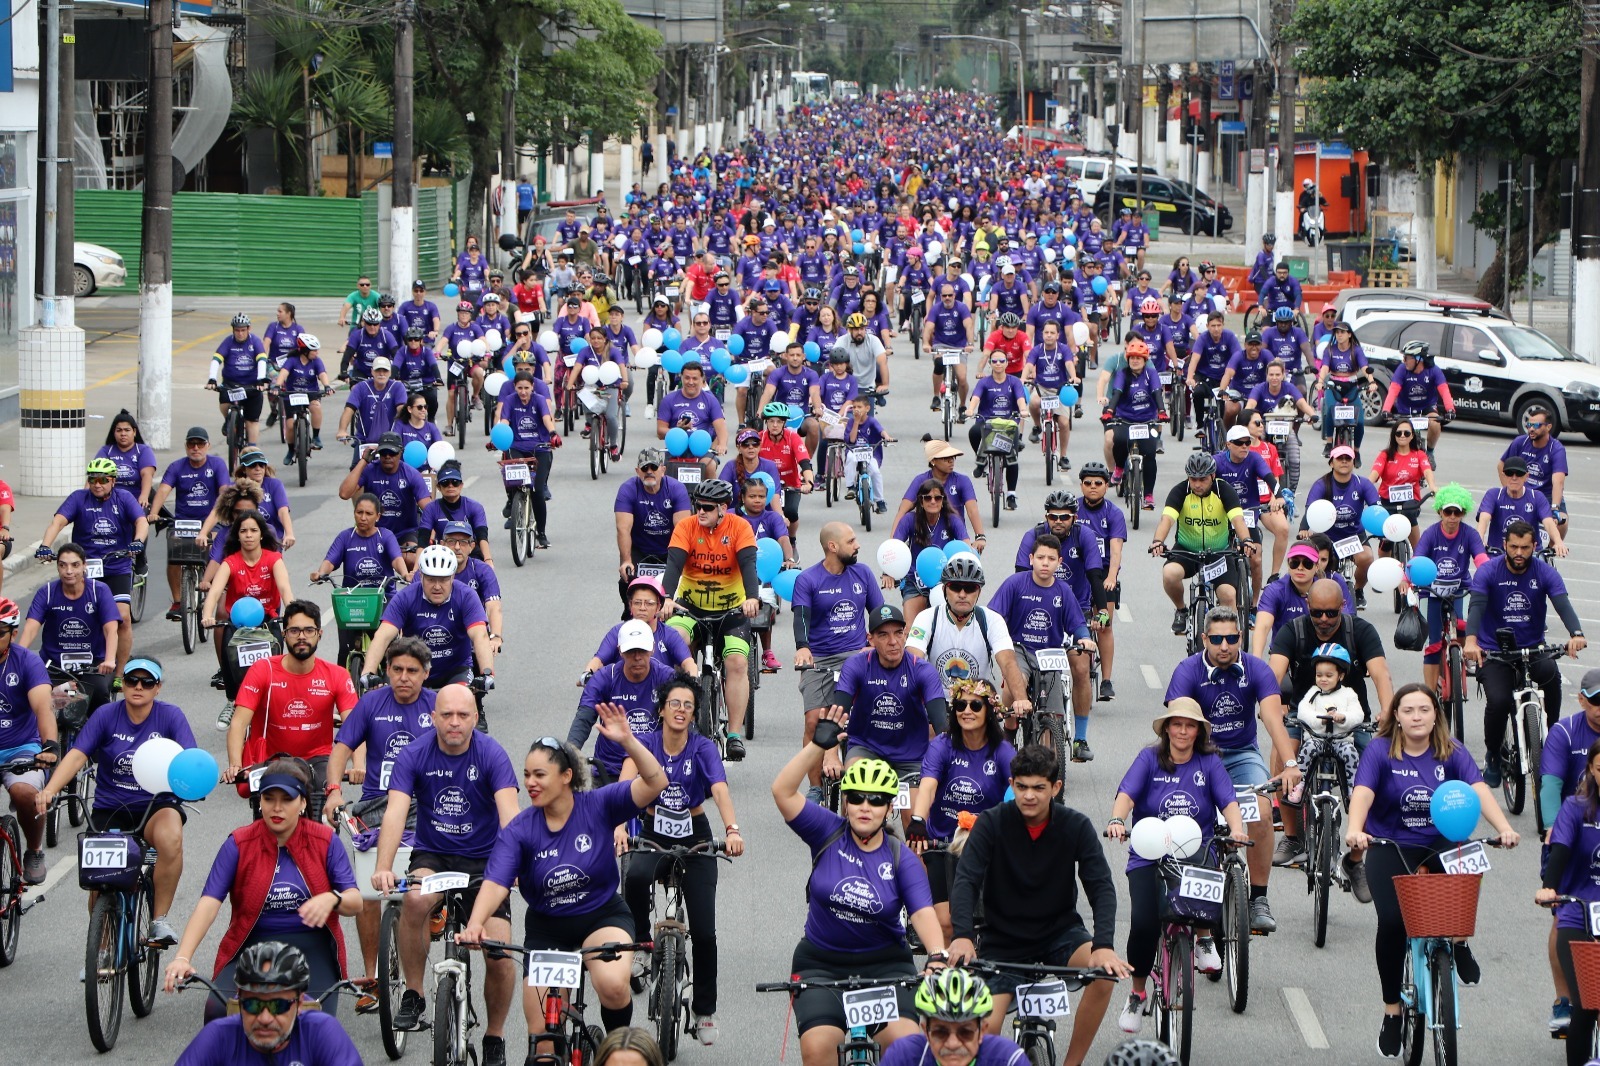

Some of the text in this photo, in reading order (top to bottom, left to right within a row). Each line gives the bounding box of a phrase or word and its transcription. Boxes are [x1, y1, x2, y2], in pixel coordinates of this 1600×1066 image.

[1451, 397, 1501, 411] olícia Civil
[507, 471, 527, 479] 0318
[679, 474, 701, 482] 0316
[1391, 491, 1412, 501] 0218
[1185, 517, 1221, 528] BRASIL
[690, 550, 728, 564] Amigos
[1338, 543, 1362, 558] 1901
[703, 565, 732, 576] Bike
[1205, 563, 1227, 580] 1397
[1040, 658, 1069, 669] 0200
[656, 818, 692, 836] 1324
[85, 850, 125, 867] 0171
[424, 879, 466, 893] 1356
[1184, 881, 1222, 900] 1320
[531, 966, 577, 986] 1743
[1020, 995, 1069, 1015] 0134
[848, 1001, 898, 1025] 0892
